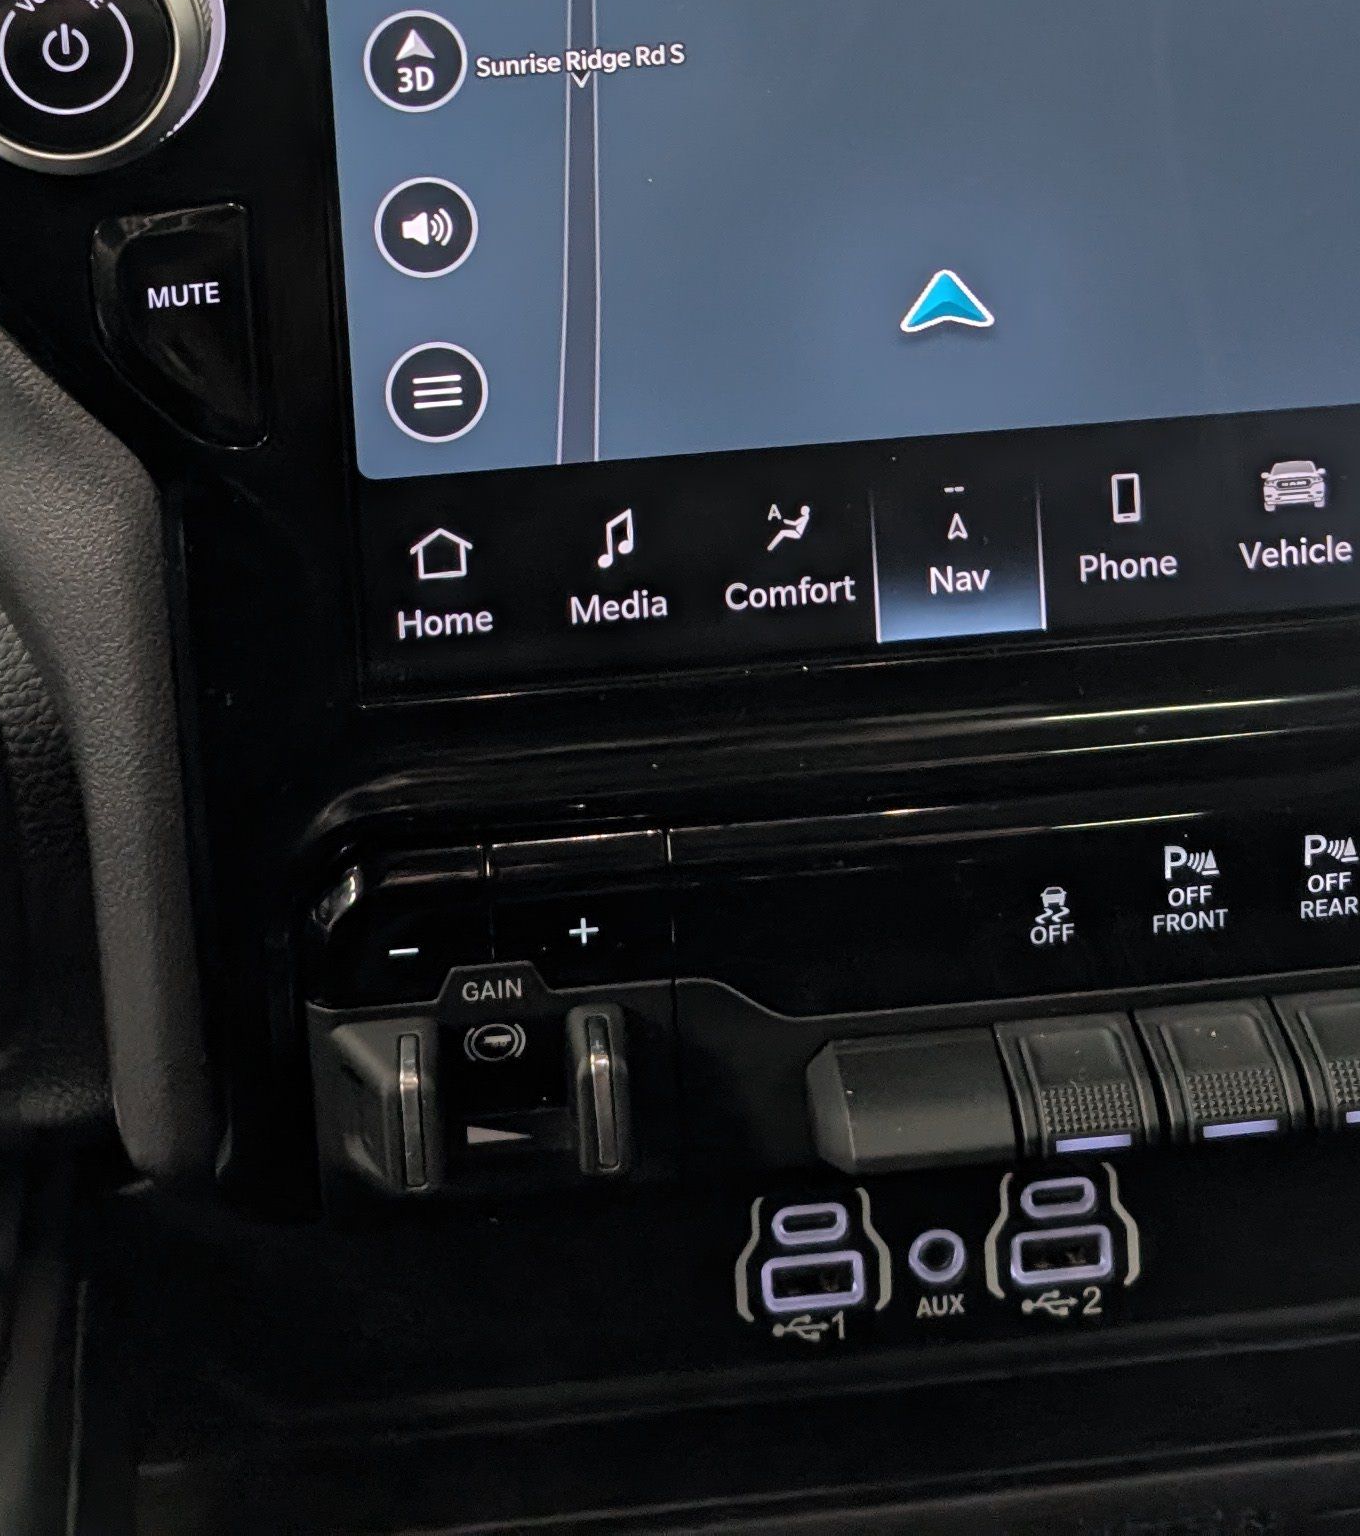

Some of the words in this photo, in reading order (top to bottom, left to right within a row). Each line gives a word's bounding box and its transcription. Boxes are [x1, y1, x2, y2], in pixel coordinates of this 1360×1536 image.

[475, 52, 562, 79] Sunrise
[565, 48, 631, 77] Ridge
[635, 45, 666, 68] Rd
[670, 43, 685, 65] S
[397, 66, 435, 94] 3D
[147, 281, 220, 309] MUTE
[1239, 534, 1353, 570] Vehicle
[929, 565, 990, 596] Nav
[1079, 550, 1178, 583] Phone
[725, 574, 856, 611] Comfort
[570, 589, 669, 625] Media
[397, 608, 494, 641] Home
[1167, 884, 1213, 907] OFF
[1307, 871, 1352, 893] OFF
[1152, 909, 1229, 934] FRONT
[1300, 896, 1359, 919] REAR
[1029, 923, 1075, 945] OFF
[461, 978, 523, 1002] GAIN
[916, 1294, 965, 1318] AUX
[1082, 1286, 1102, 1315] 2
